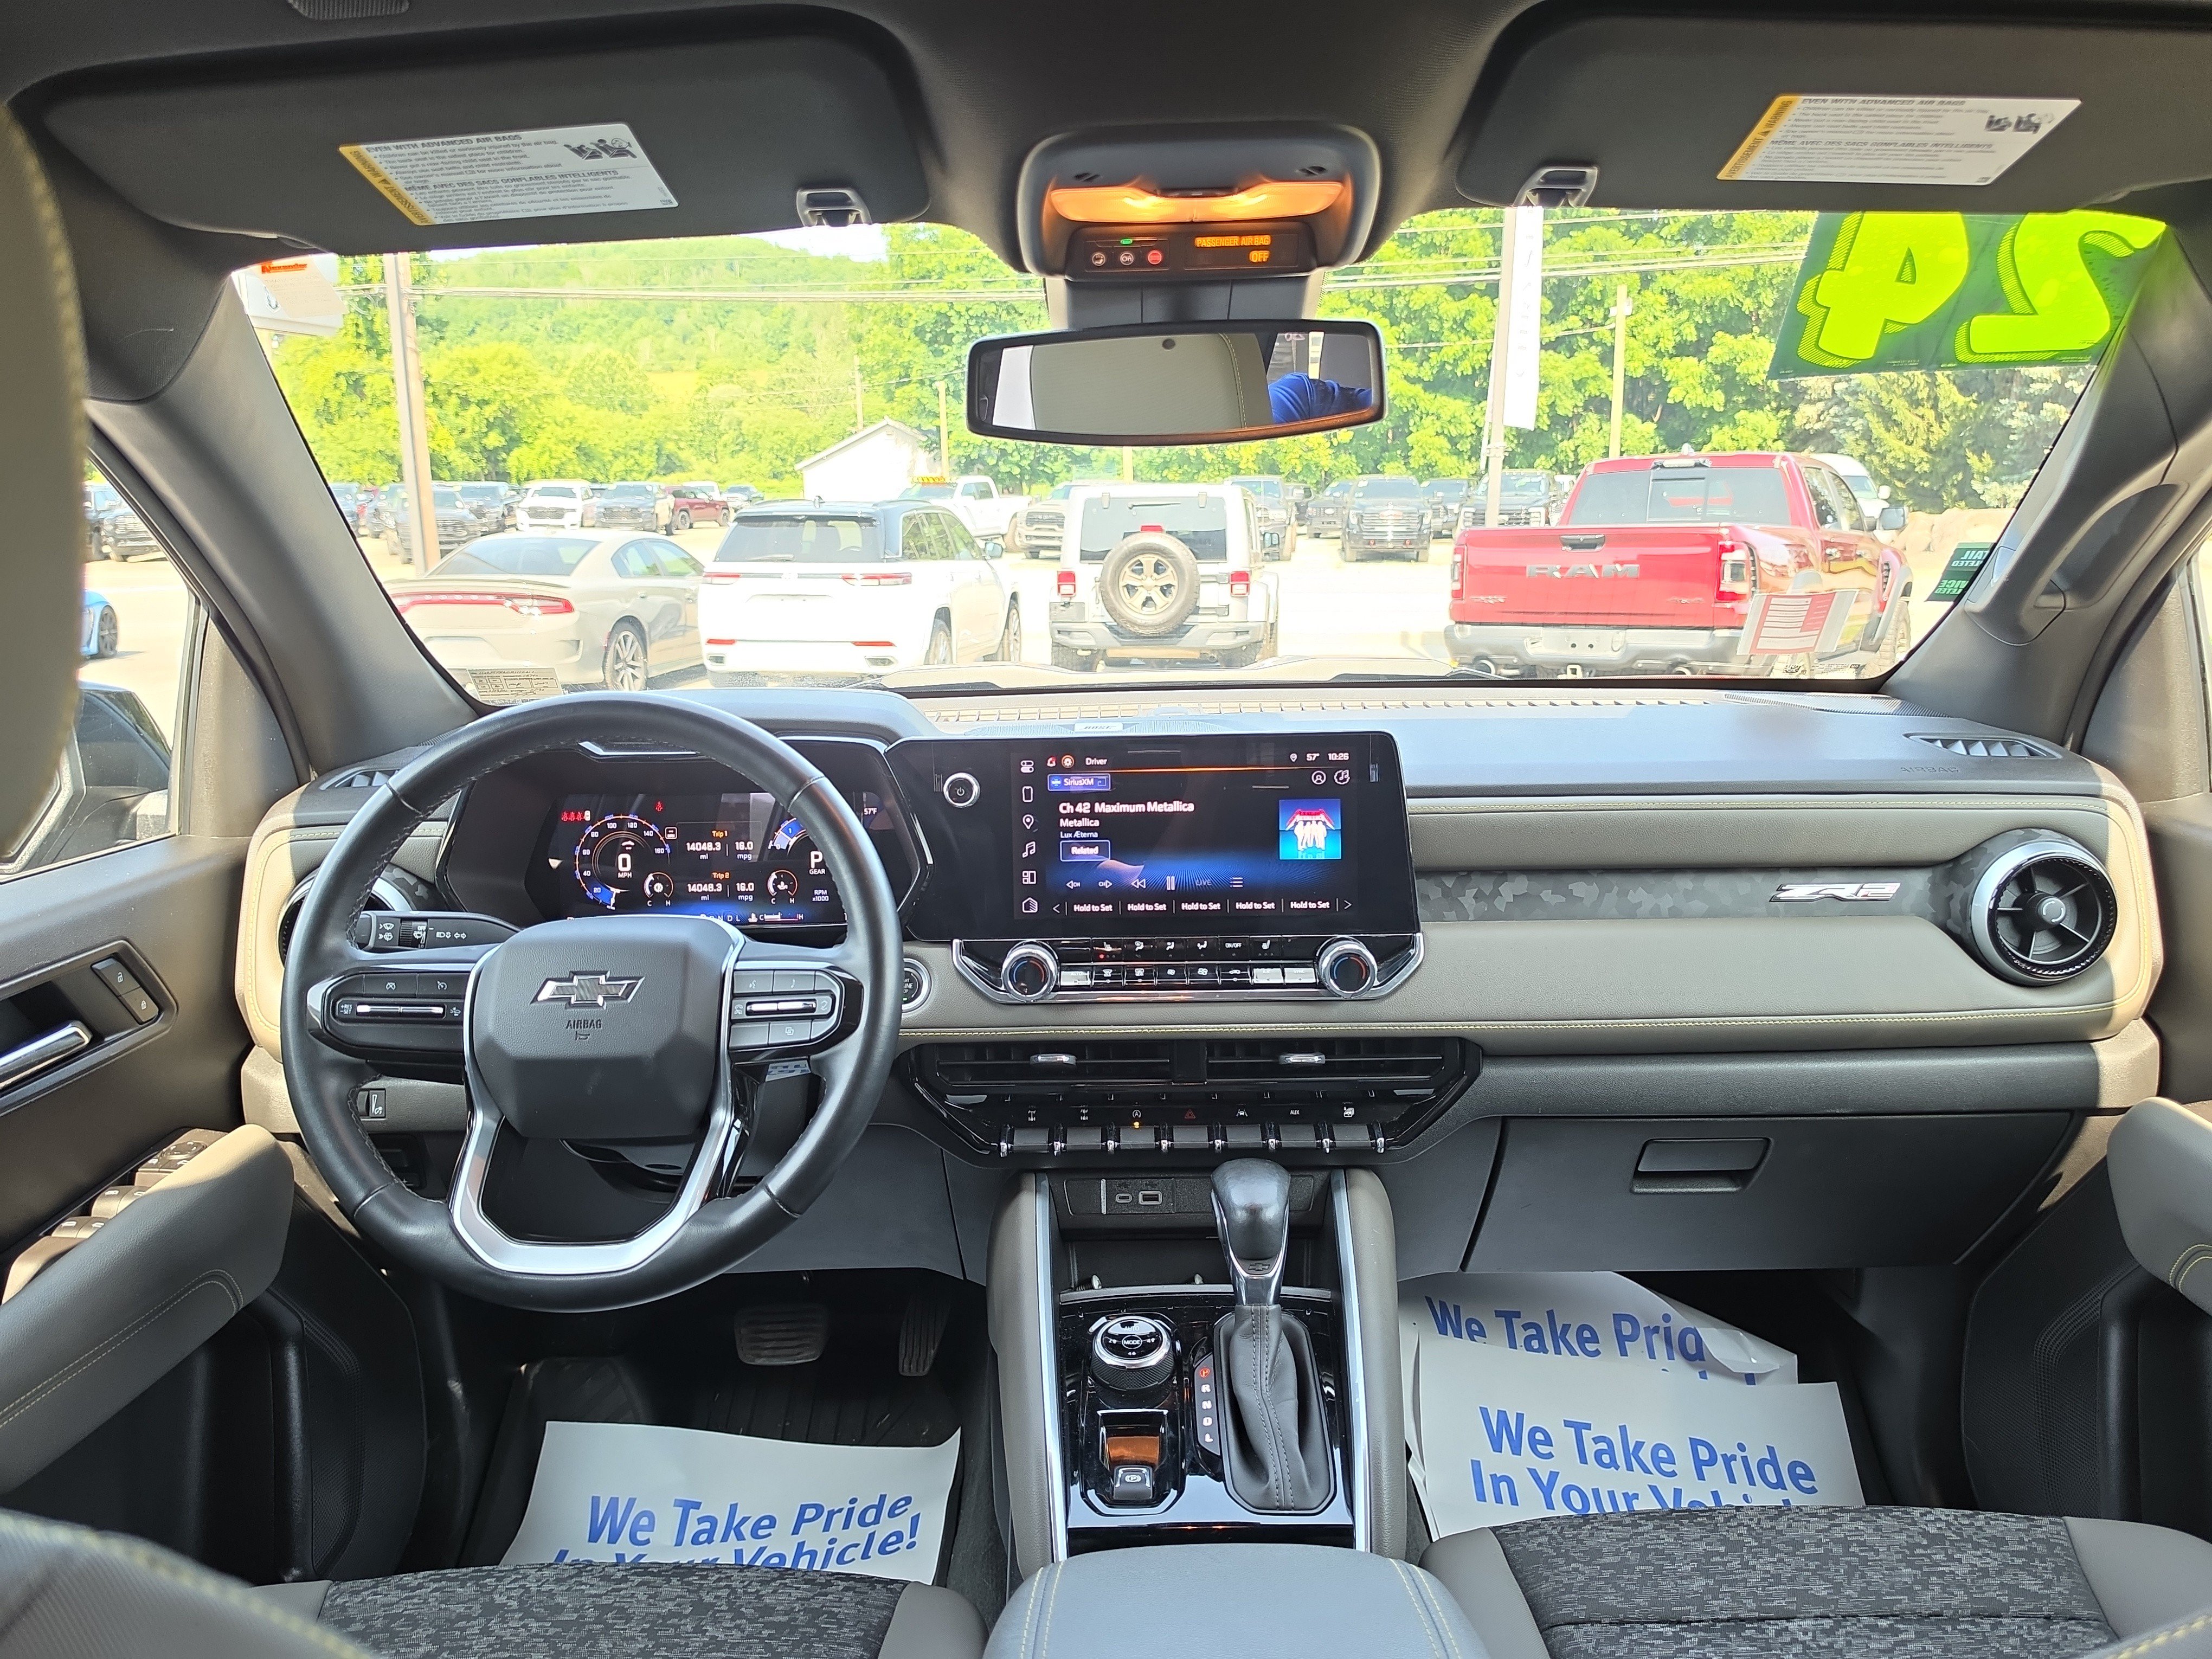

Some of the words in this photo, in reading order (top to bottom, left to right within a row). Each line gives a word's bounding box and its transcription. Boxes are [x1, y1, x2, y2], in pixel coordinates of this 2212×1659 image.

[1763, 101, 1793, 129] WARNING
[419, 138, 474, 147] ADVANCED
[1725, 138, 1764, 178] AVERTISSEMENT
[499, 175, 558, 183] GONFLABLES
[557, 170, 619, 179] INTELLIGENTS
[1196, 237, 1238, 247] PASSENGER
[1254, 237, 1269, 245] BAG
[1251, 252, 1269, 263] OFF
[1526, 563, 1641, 578] RAM
[1085, 757, 1108, 766] Driver
[1306, 753, 1320, 761] 57°
[1328, 753, 1349, 761] 10:26
[1064, 777, 1094, 786] SiriusXM
[1059, 803, 1074, 814] Ch
[1075, 802, 1091, 814] 42
[1095, 802, 1146, 813] Maximum
[1147, 801, 1194, 813] Metallica
[1059, 818, 1100, 827] Metallica
[1073, 831, 1098, 839] Æterna
[1071, 846, 1099, 854] Related
[618, 853, 631, 872] 0
[810, 851, 823, 869] P
[736, 883, 754, 891] 16.0
[1769, 883, 1901, 902] ZR2
[1073, 904, 1090, 912] Hold
[1127, 903, 1144, 911] Hold
[1181, 903, 1198, 911] Hold
[1208, 902, 1221, 910] Set
[1236, 902, 1252, 910] Hold
[1290, 901, 1308, 909] Hold
[1317, 901, 1330, 909] Set
[566, 1019, 602, 1030] AIRBAG
[1424, 1295, 1487, 1342] We
[1495, 1309, 1602, 1358] Take
[1201, 1384, 1211, 1392] R
[1202, 1400, 1212, 1409] N
[1203, 1417, 1213, 1426] D
[1204, 1434, 1213, 1442] L
[1479, 1405, 1554, 1461] We
[1564, 1419, 1679, 1478] Take
[1688, 1436, 1818, 1495] Pride
[1470, 1458, 1520, 1507] In
[1527, 1467, 1640, 1518] Your
[587, 1495, 655, 1547] We
[673, 1498, 777, 1548] Take
[790, 1493, 913, 1536] Pride
